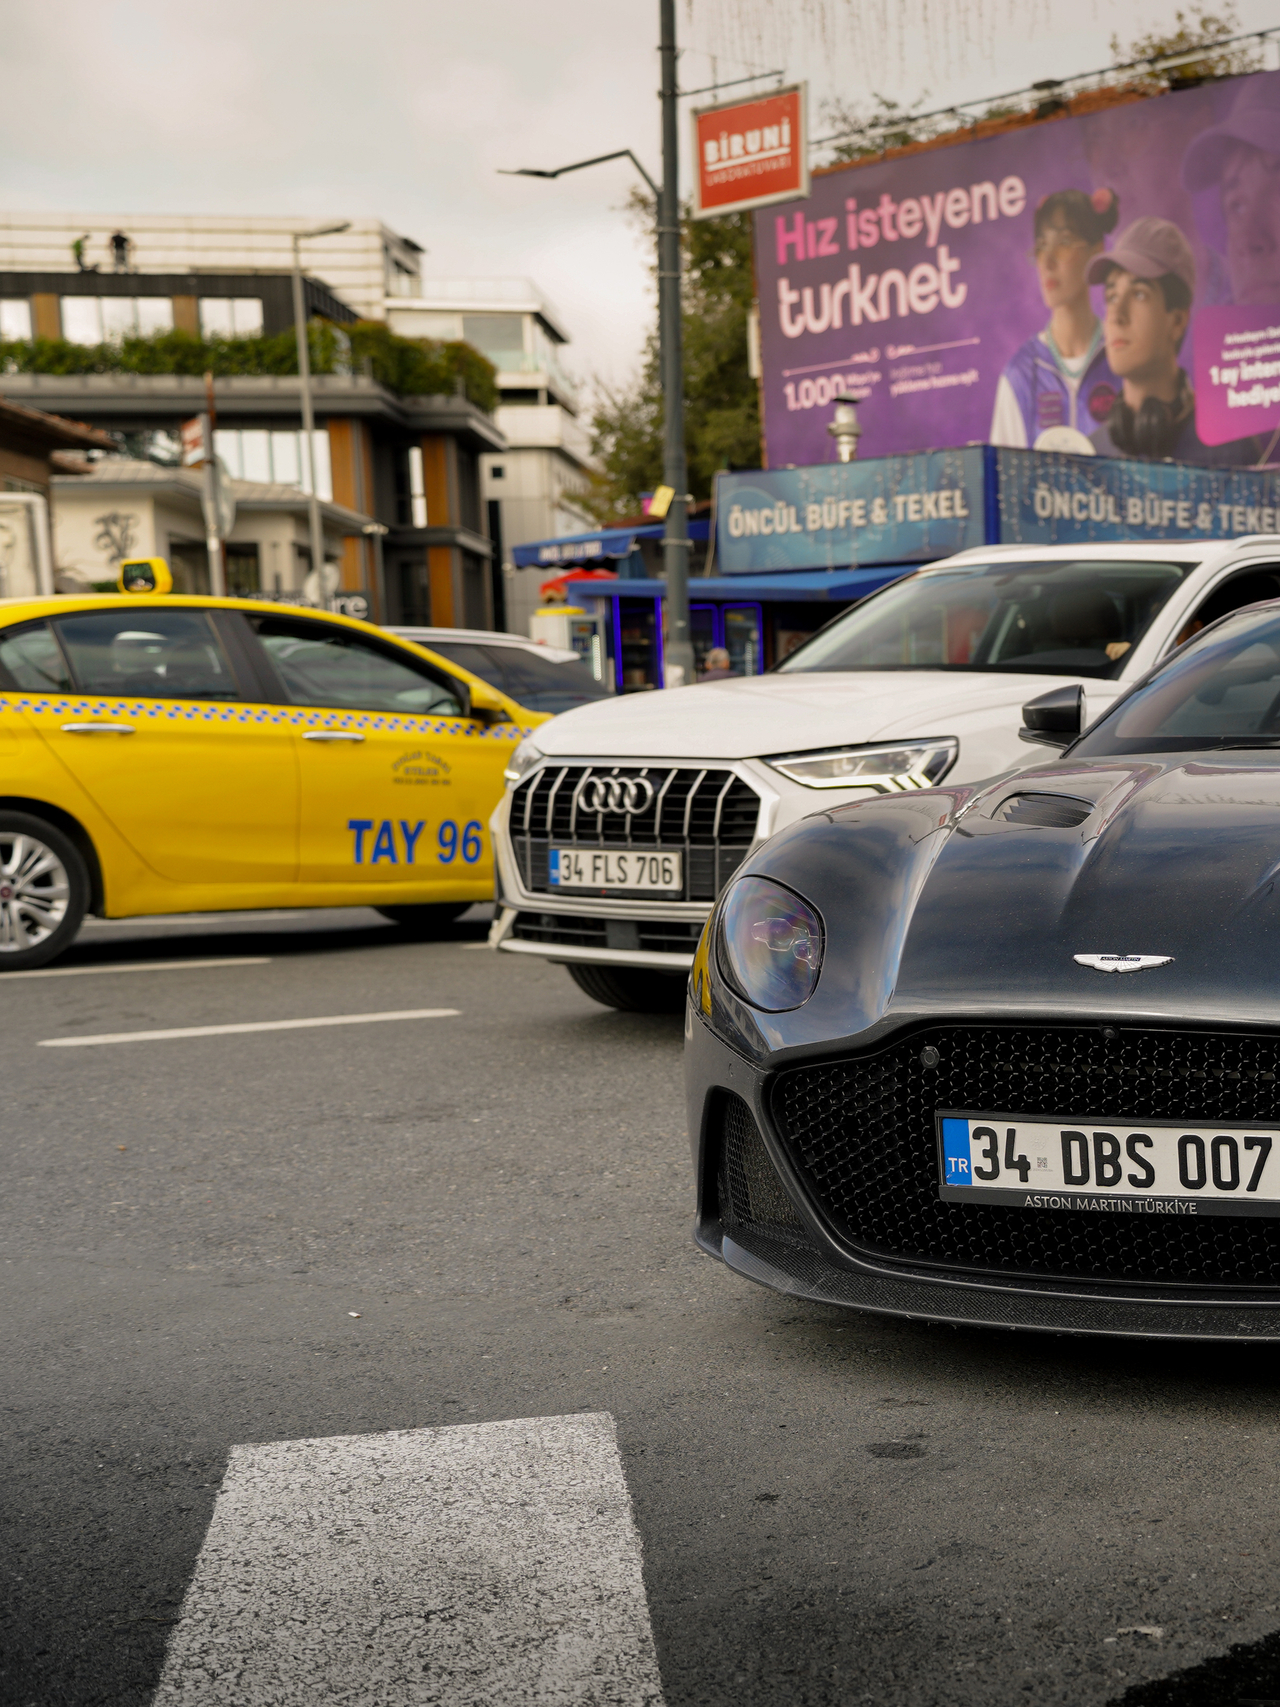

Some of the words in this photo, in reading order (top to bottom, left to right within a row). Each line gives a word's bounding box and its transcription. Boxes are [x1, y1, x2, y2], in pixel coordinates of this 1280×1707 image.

[703, 115, 792, 165] BİRUNİ
[775, 211, 840, 266] Hız
[845, 175, 1027, 248] isteyene
[776, 243, 968, 338] turknet
[783, 373, 847, 411] 1.000
[1208, 365, 1220, 386] 1
[1220, 366, 1239, 388] ay
[728, 500, 802, 538] ÖNCÜL
[806, 495, 867, 532] BÜFE
[870, 497, 888, 525] &
[893, 489, 970, 523] TEKEL
[1034, 484, 1121, 524] ÖNCÜL
[1127, 493, 1192, 530] BÜFE
[1196, 502, 1213, 532] &
[347, 818, 427, 865] TAY
[437, 818, 483, 866] 96
[562, 854, 584, 883] 34
[592, 854, 628, 884] FLS
[636, 856, 674, 885] 706
[948, 1157, 969, 1174] TR
[972, 1126, 1031, 1182] 34
[1060, 1130, 1155, 1188] DBS
[1177, 1134, 1273, 1192] 007
[1024, 1195, 1072, 1210] ASTON
[1076, 1198, 1133, 1213] MARTIN
[1135, 1198, 1198, 1215] TÜRKİYE
